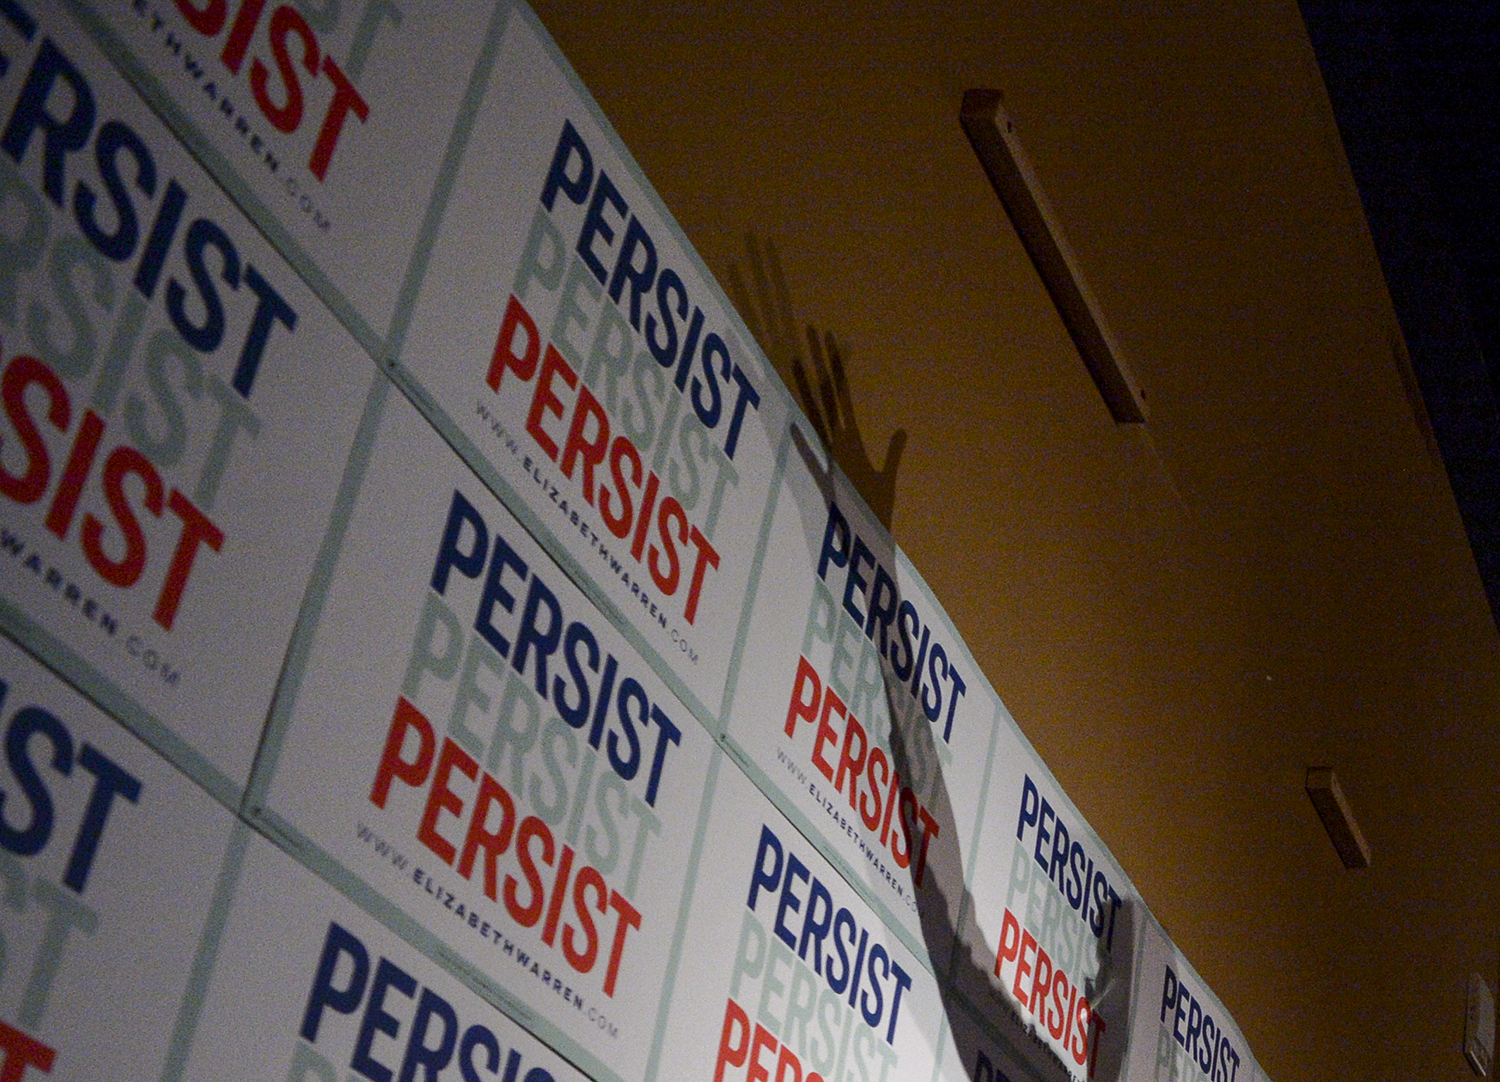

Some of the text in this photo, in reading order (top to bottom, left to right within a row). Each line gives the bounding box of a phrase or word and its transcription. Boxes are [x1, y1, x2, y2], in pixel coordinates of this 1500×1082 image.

[0, 0, 298, 400] RSIST
[541, 117, 760, 460] PERSIST
[487, 295, 720, 624] PERSIST
[514, 205, 740, 541] PERSIST
[400, 591, 661, 901] PERSIST
[429, 489, 681, 811] PERSIST
[784, 658, 939, 888] PERSIST
[816, 501, 966, 745] PERSIST
[370, 696, 641, 994] PERSIST
[748, 823, 912, 1047] PERSIST
[1017, 774, 1122, 954] PERSIST
